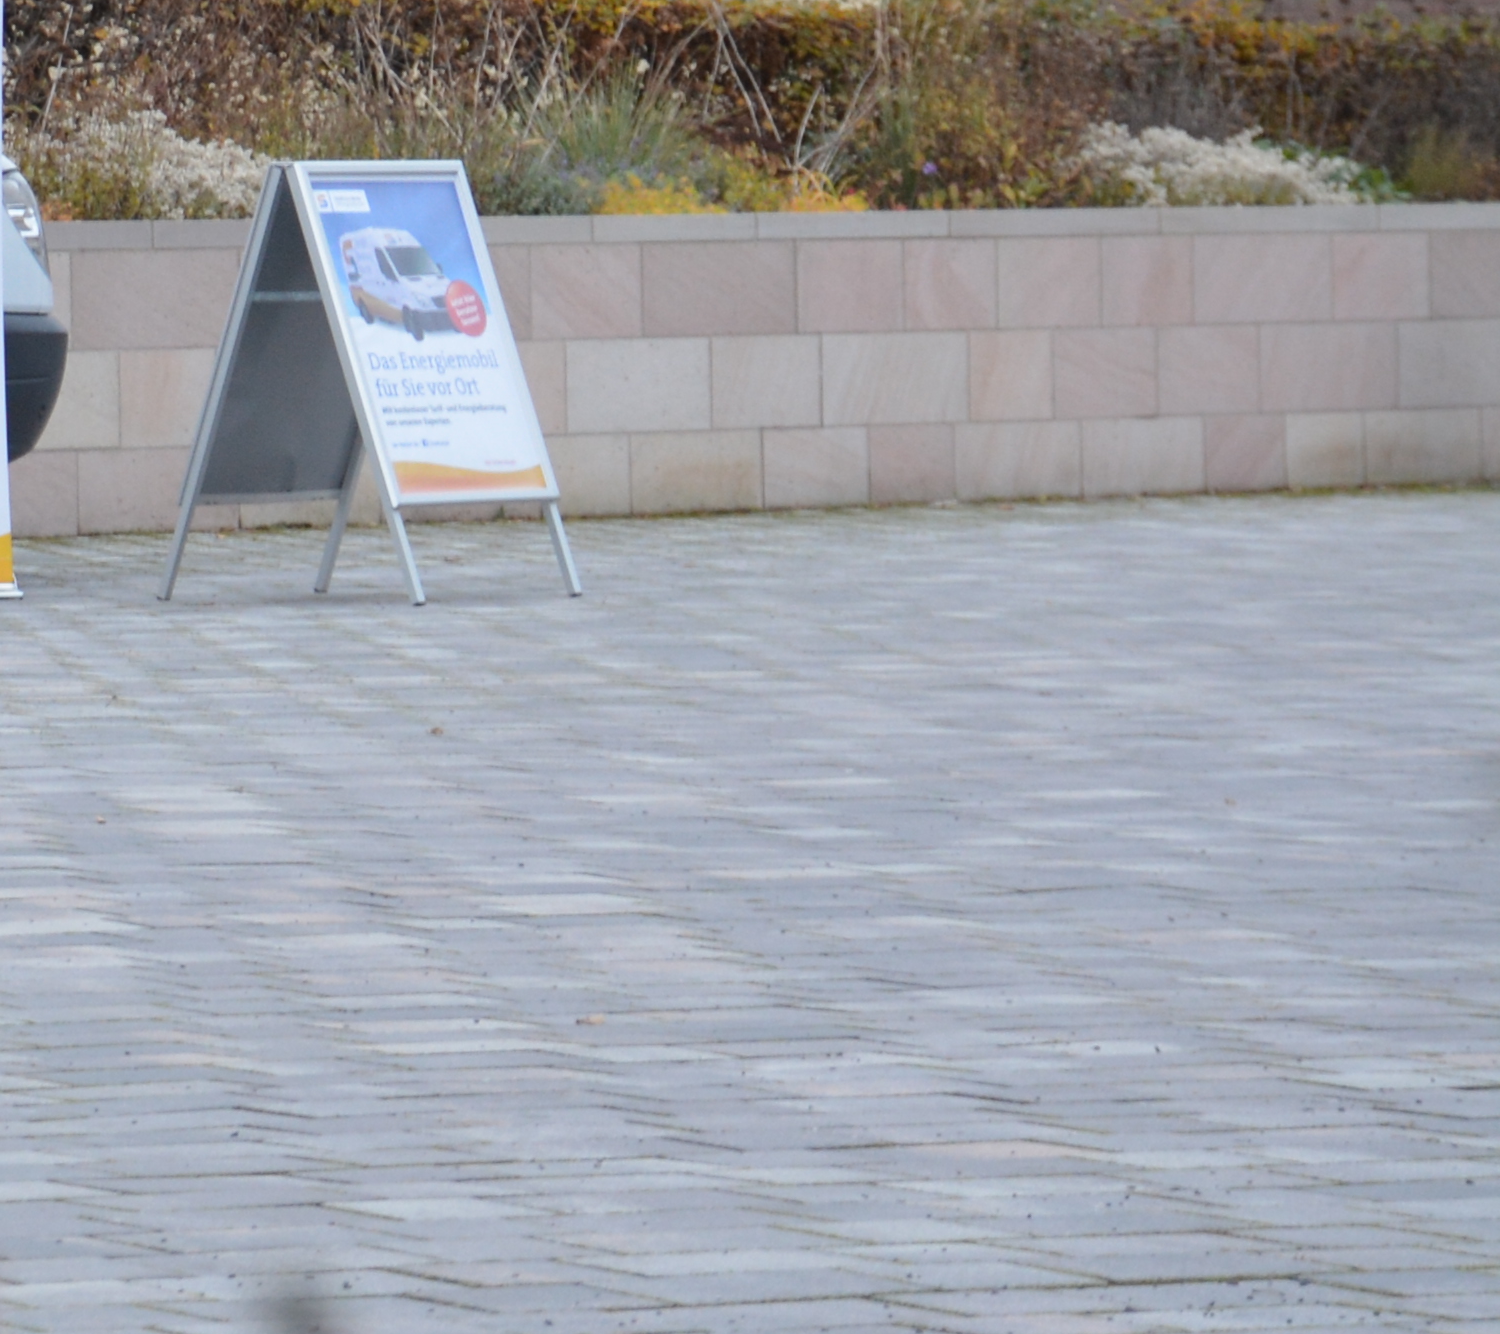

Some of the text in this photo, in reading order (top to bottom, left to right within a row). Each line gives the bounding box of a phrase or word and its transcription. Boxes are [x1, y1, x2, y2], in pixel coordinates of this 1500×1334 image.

[367, 348, 499, 374] Das Energiemobil
[375, 376, 481, 397] für Sie vor Ort
